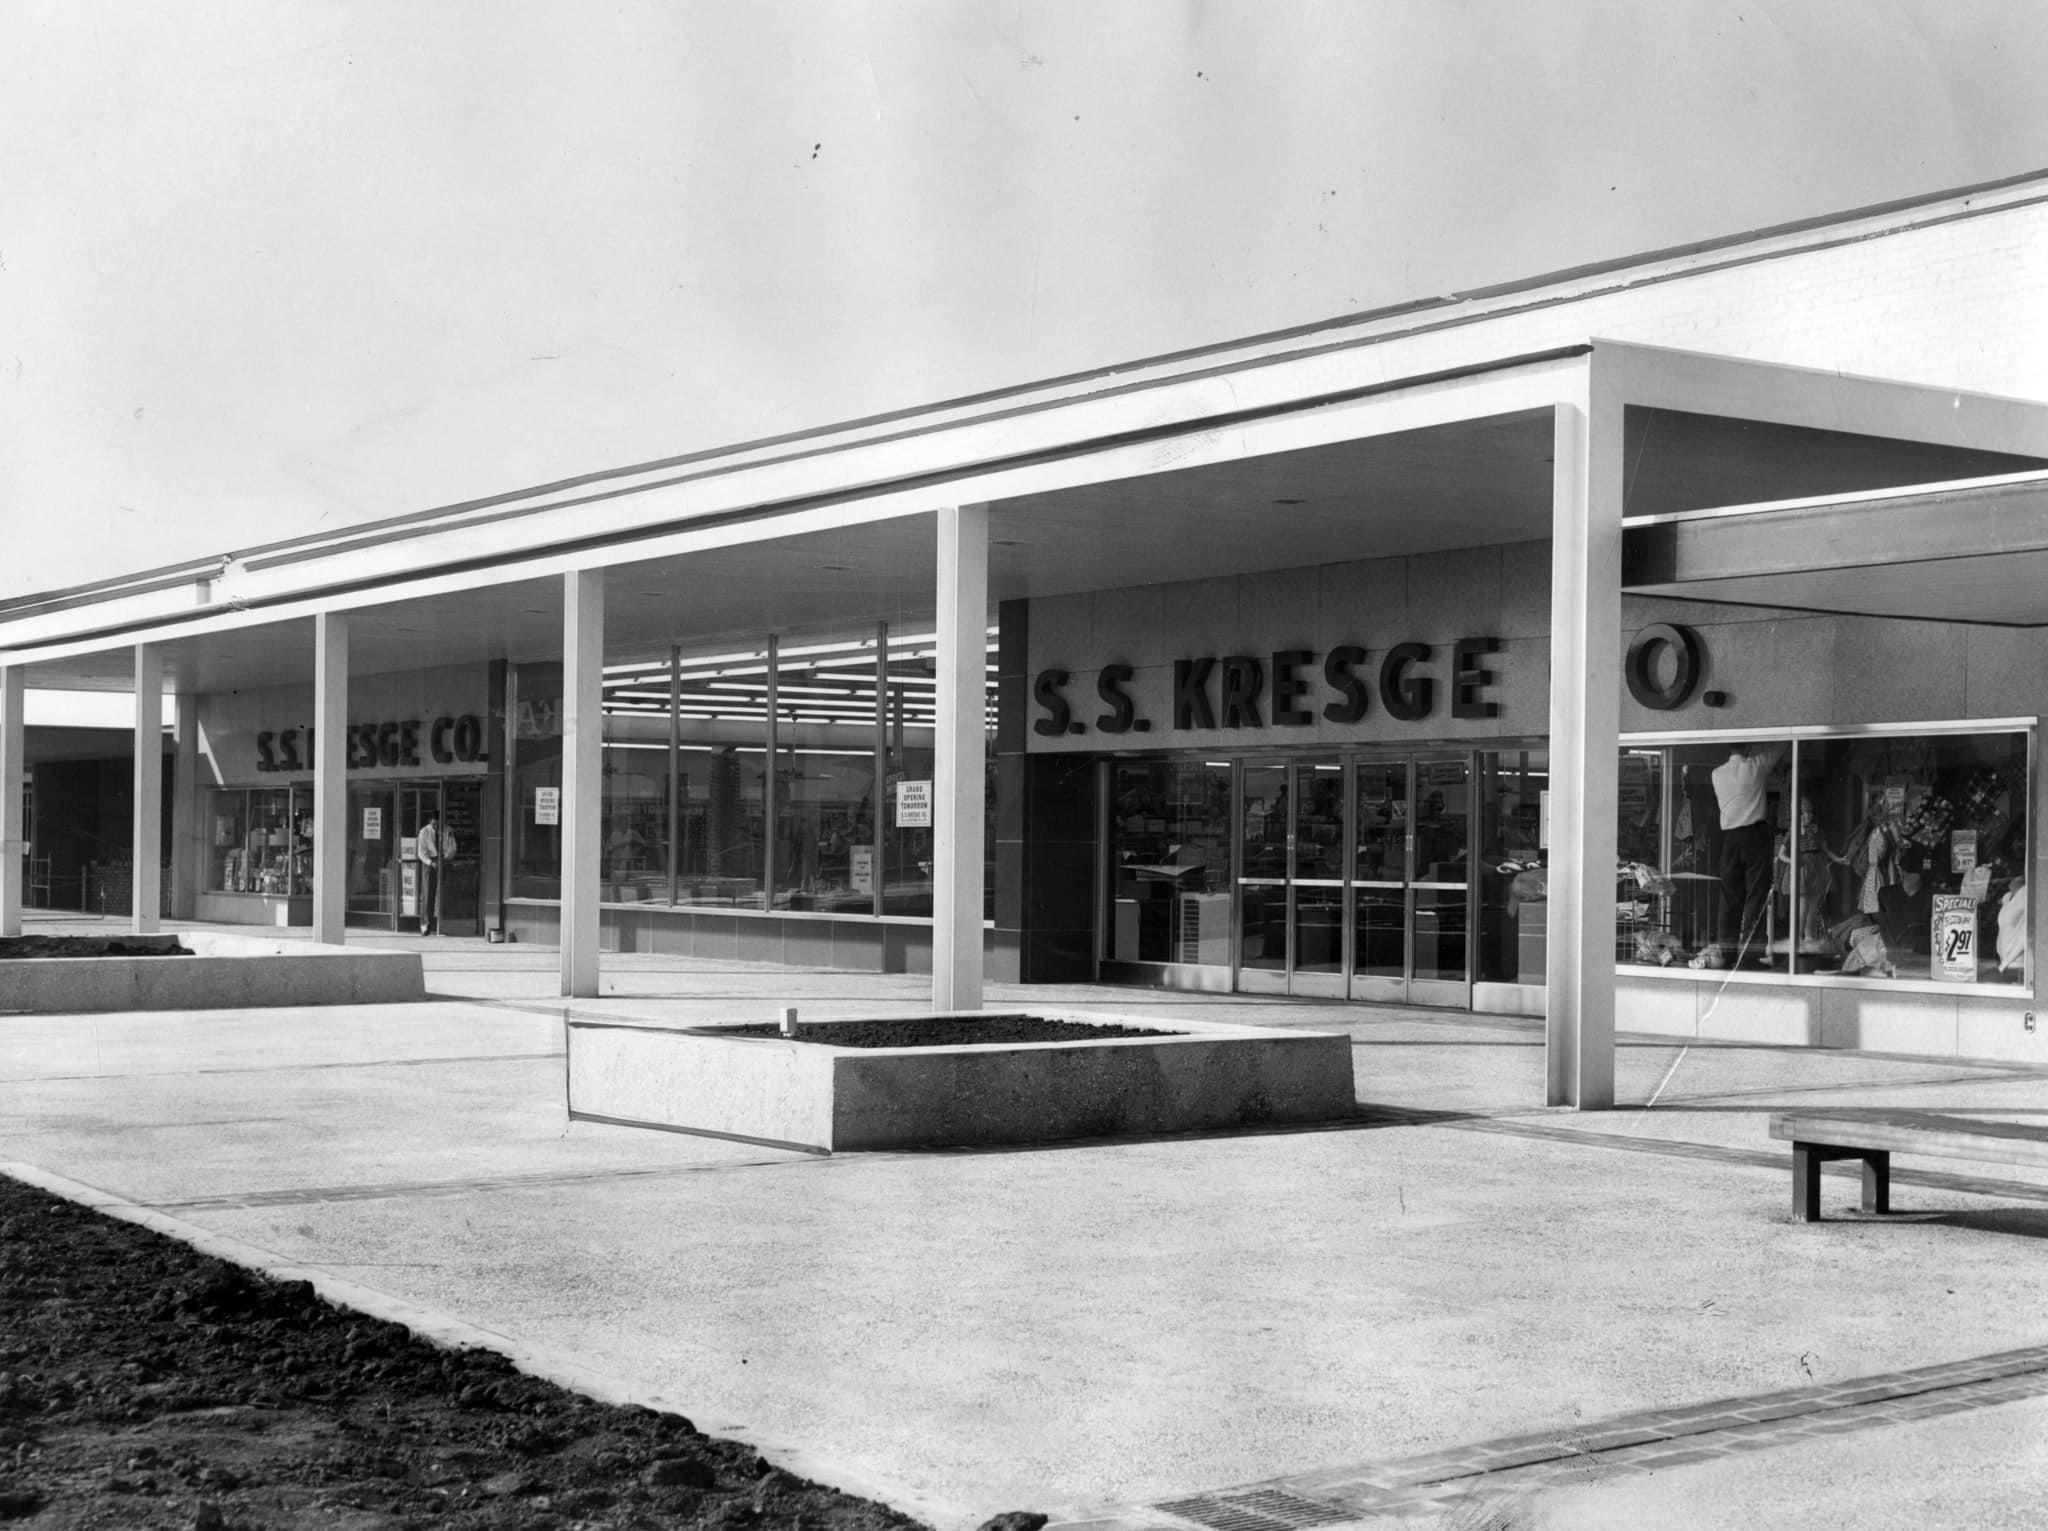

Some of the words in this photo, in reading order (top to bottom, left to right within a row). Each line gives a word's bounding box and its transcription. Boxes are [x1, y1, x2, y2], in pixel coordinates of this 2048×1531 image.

[1034, 664, 1151, 736] S.S.
[1173, 636, 1500, 731] KRESGE
[1625, 622, 1727, 711] O.
[307, 719, 421, 770] ESGE
[430, 714, 489, 764] CO.
